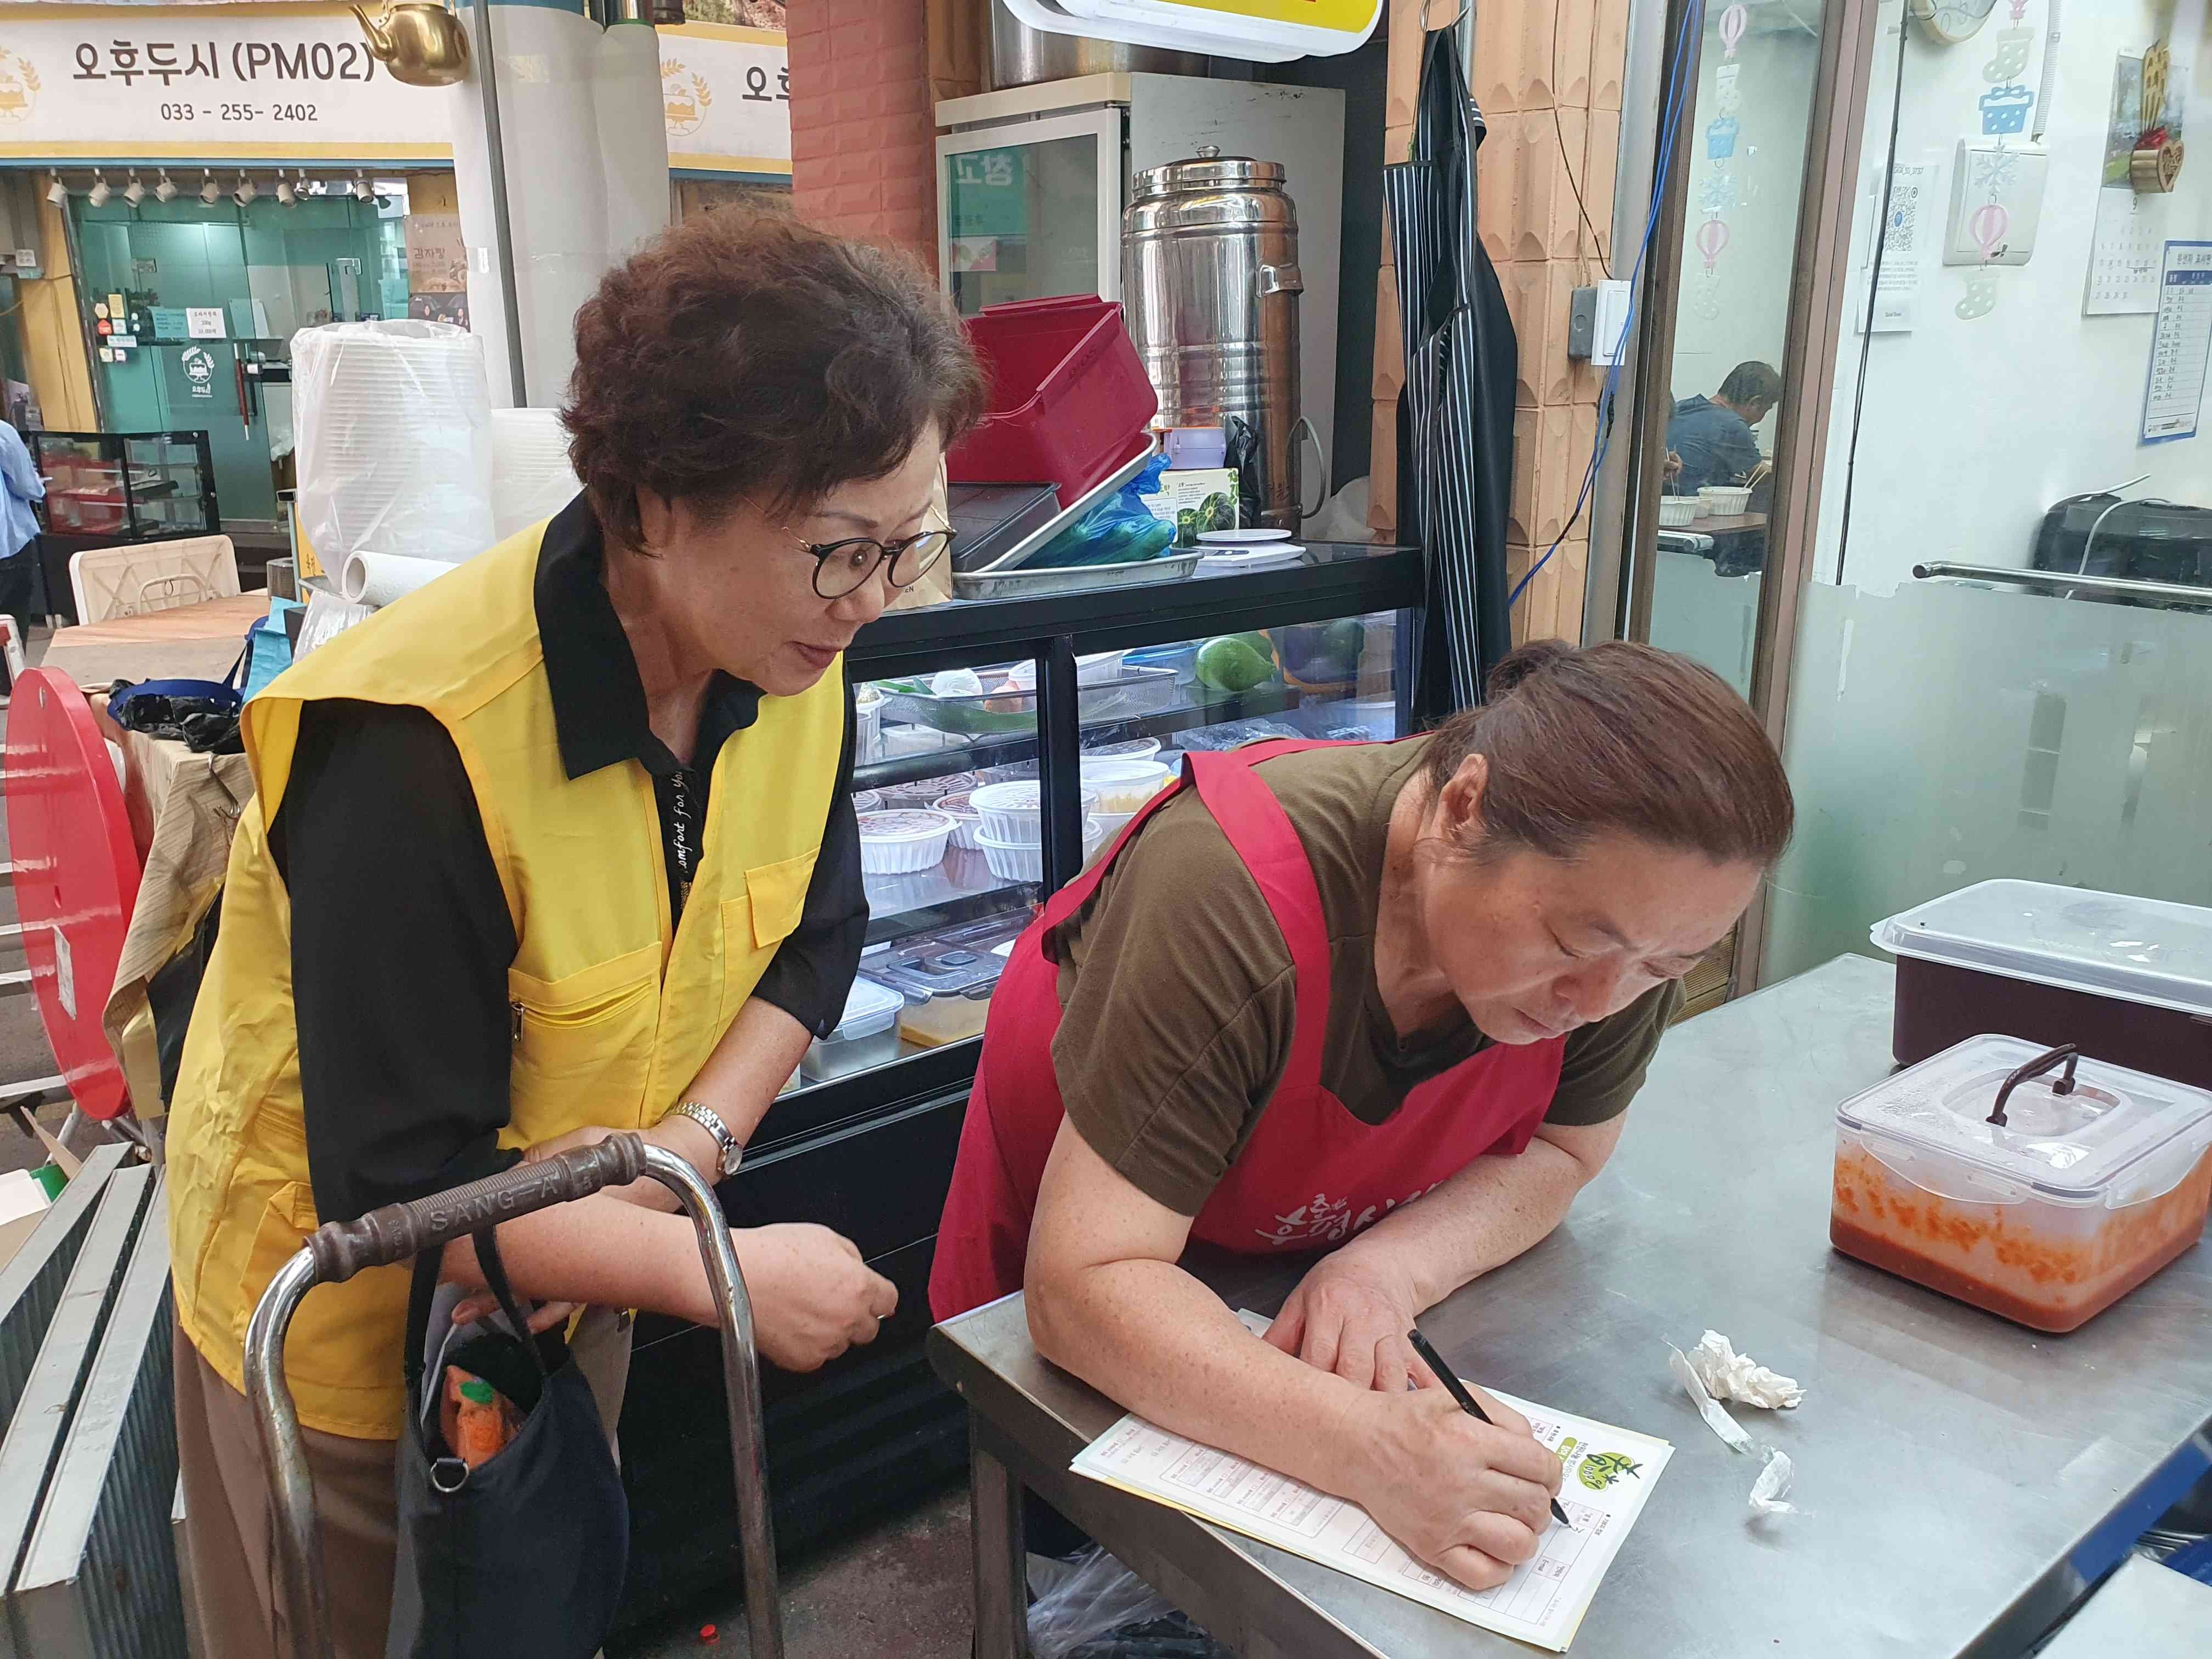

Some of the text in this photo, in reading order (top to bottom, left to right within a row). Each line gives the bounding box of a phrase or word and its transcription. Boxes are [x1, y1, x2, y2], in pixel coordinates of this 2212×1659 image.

[72, 39, 375, 86] 오후두시 (PM02)
[161, 104, 194, 121] 033
[273, 105, 319, 122] 2402
[672, 771, 689, 793] yo
[674, 794, 691, 819] for
[673, 821, 692, 873] omfort
